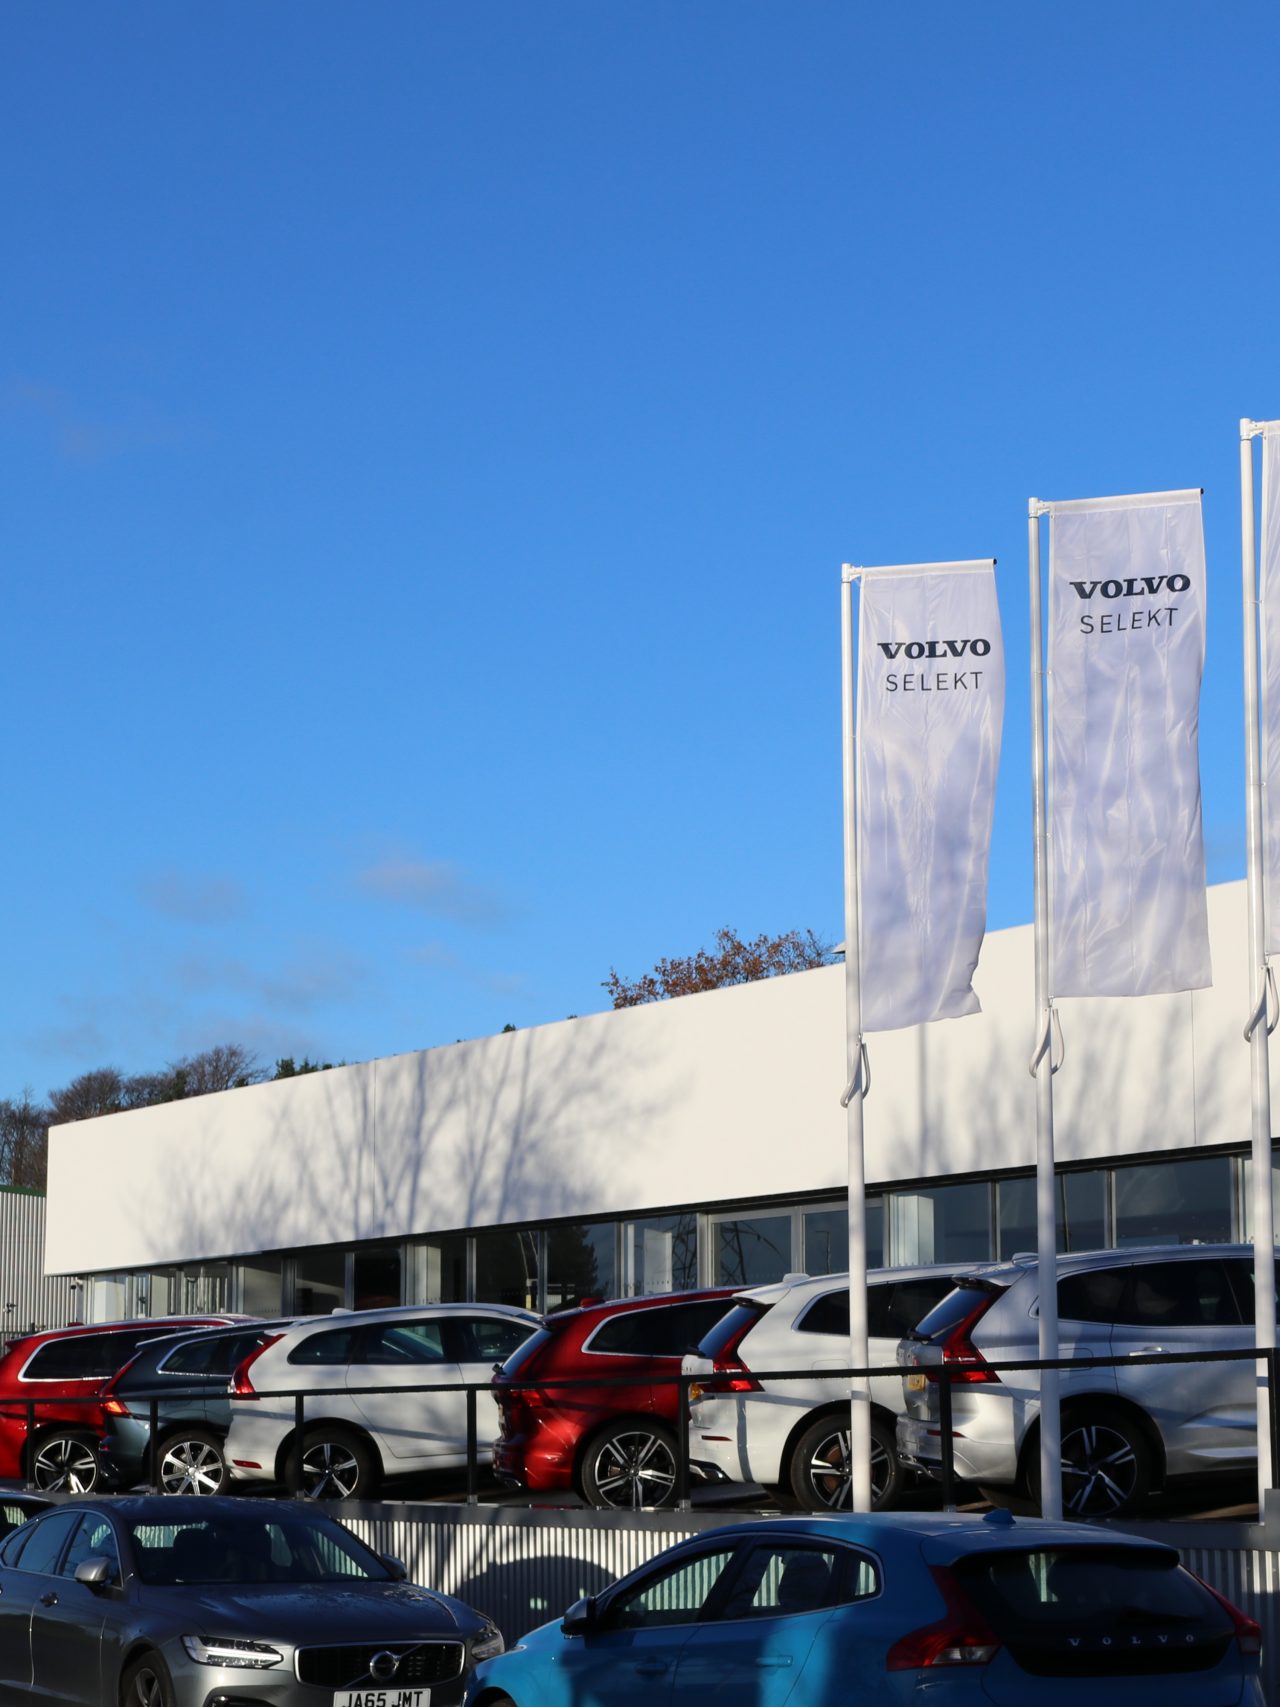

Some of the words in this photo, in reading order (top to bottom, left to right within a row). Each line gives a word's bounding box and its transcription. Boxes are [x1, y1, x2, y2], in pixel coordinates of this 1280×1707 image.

[1069, 573, 1191, 600] VOLVO
[1080, 607, 1179, 635] SELEKT
[877, 638, 991, 660] VOLVO
[885, 671, 984, 692] SELEKT
[1067, 1634, 1195, 1647] VOLVO
[342, 1692, 387, 1707] JA65
[391, 1691, 423, 1707] JMT
